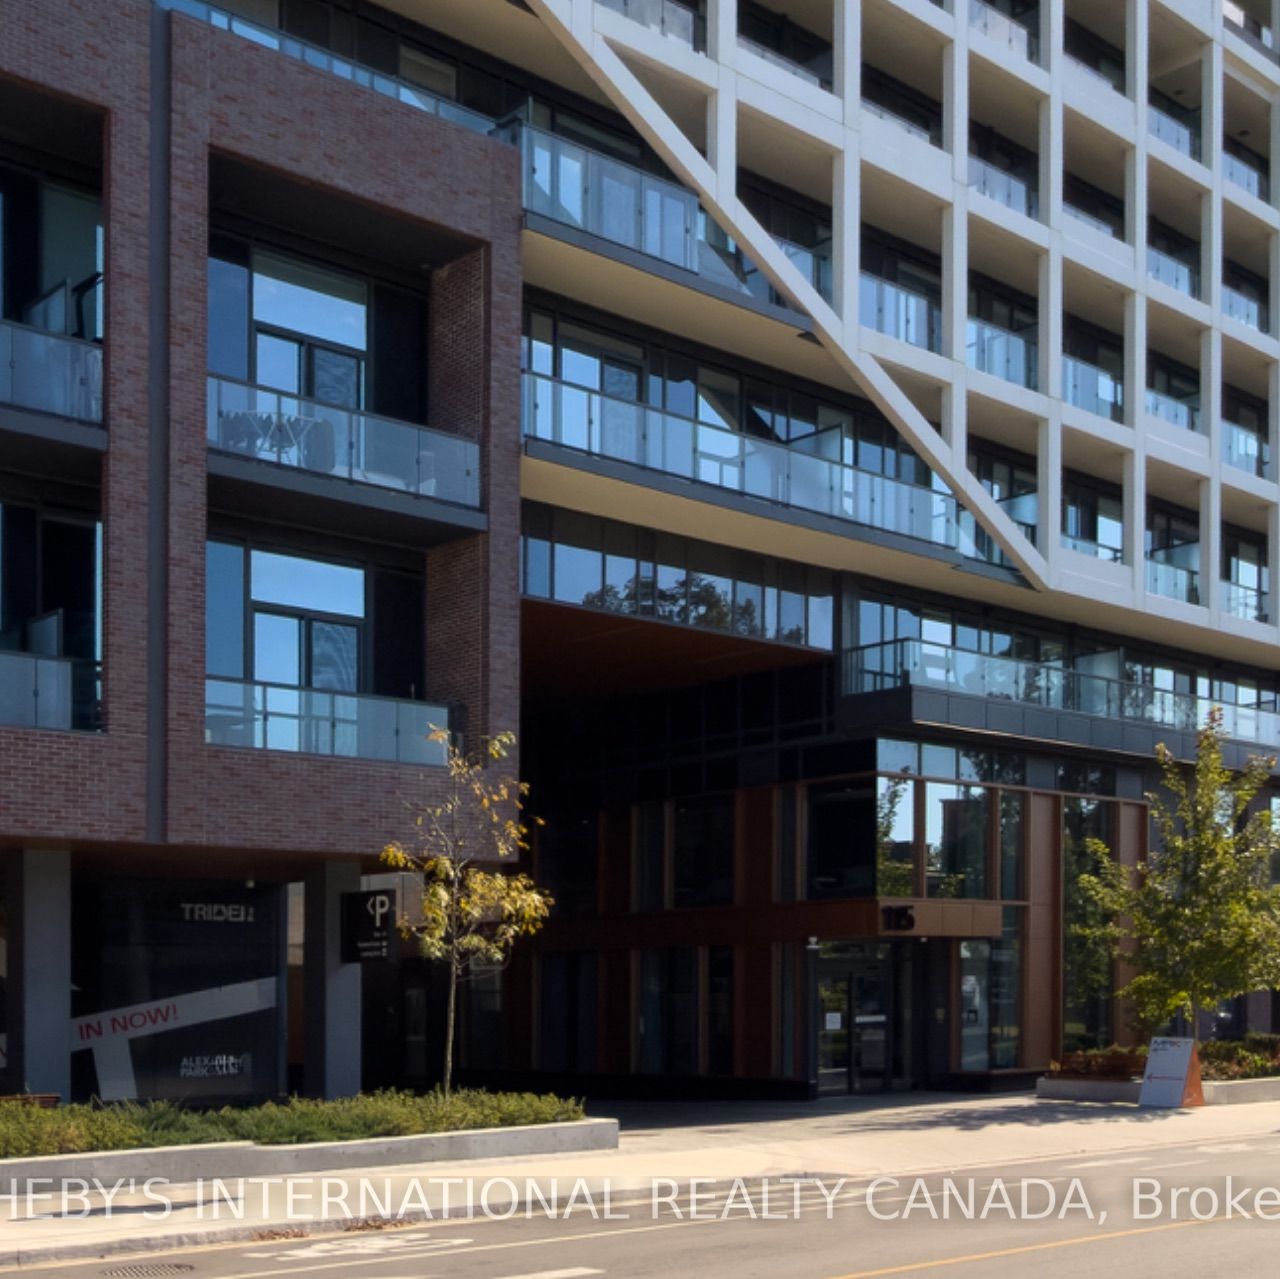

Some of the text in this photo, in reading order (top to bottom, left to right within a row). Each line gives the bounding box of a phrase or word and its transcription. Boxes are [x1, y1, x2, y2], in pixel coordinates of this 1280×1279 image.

[375, 895, 390, 927] P
[78, 1004, 178, 1040] IN NOW!
